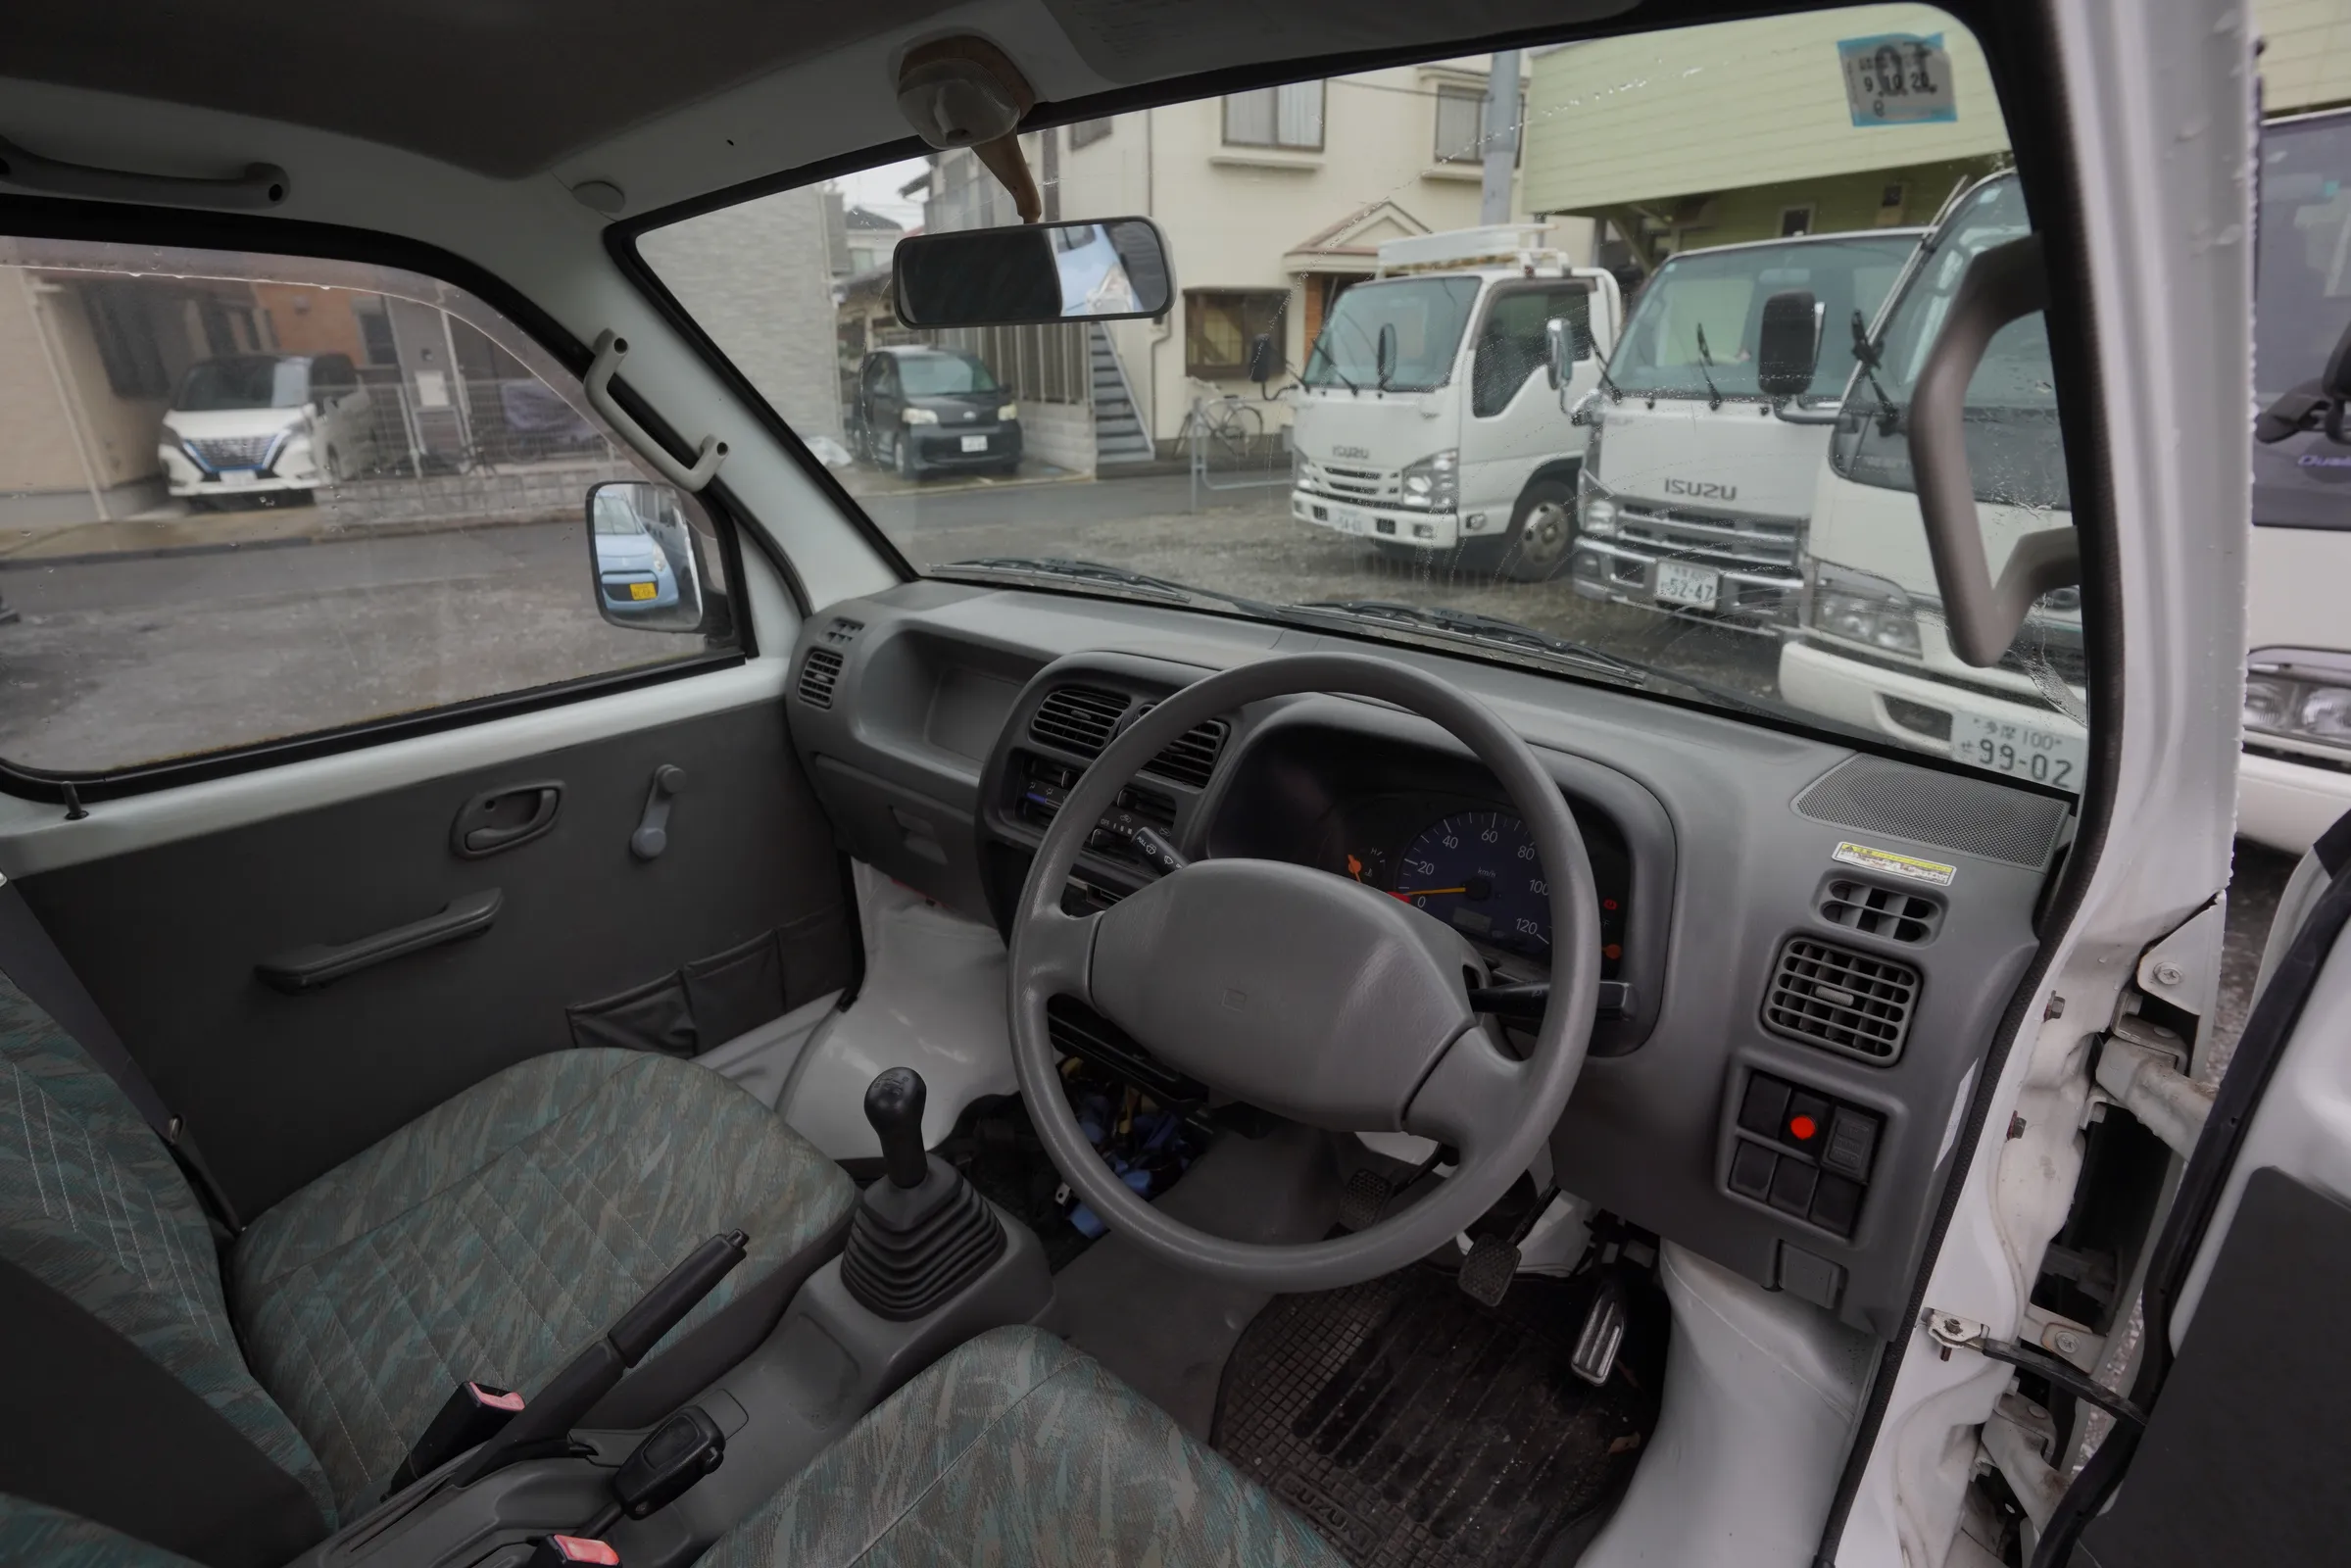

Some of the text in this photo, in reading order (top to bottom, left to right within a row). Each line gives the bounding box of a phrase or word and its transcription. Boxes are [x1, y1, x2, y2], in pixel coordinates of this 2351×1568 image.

[1333, 445, 1369, 460] ISUZU
[1665, 477, 1737, 501] ISUZU
[2023, 730, 2054, 751] 100
[1980, 738, 2073, 788] 99-02
[1137, 836, 1147, 847] PULL
[1442, 835, 1458, 849] 40
[1481, 829, 1498, 843] 60
[1517, 846, 1535, 860] 80
[1417, 861, 1435, 875] 20
[1477, 867, 1496, 878] km/h
[1529, 879, 1548, 896] 100
[1417, 896, 1426, 908] 0
[1516, 917, 1538, 935] 120
